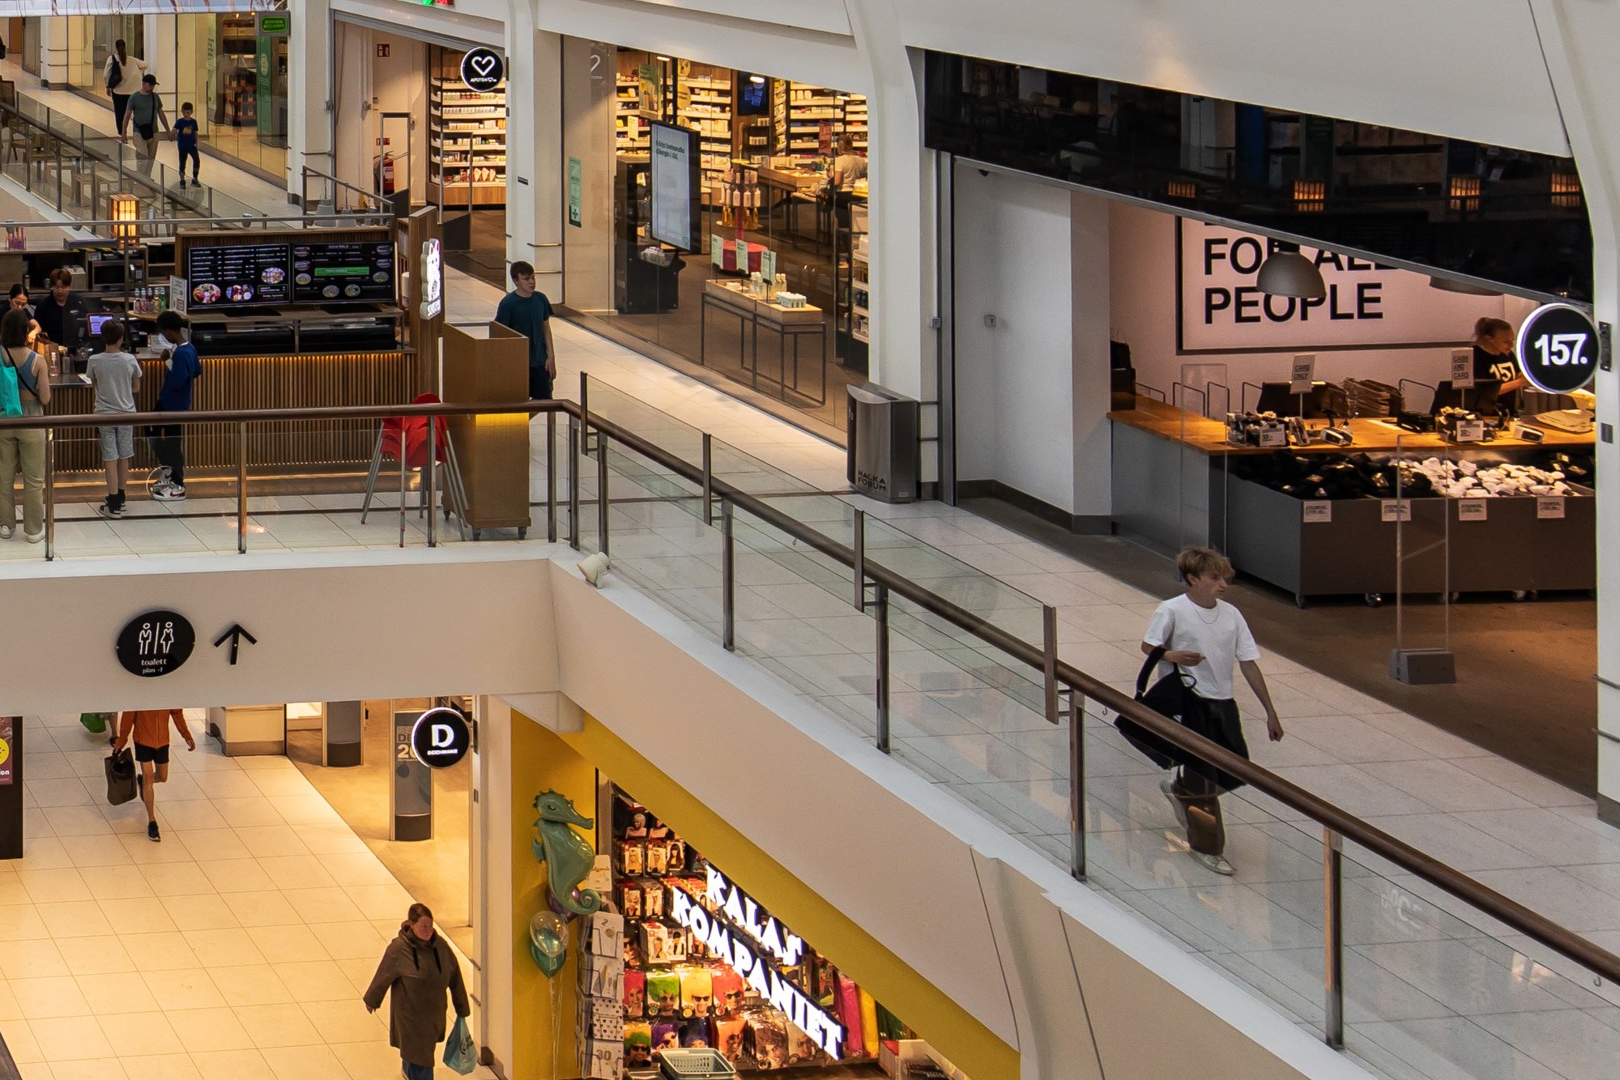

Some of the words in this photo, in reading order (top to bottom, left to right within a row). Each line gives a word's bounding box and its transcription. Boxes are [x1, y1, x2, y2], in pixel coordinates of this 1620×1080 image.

[1204, 281, 1384, 325] PEOPLE
[857, 469, 886, 485] NACKA
[857, 476, 887, 492] FORUM
[141, 658, 167, 666] toalett
[142, 667, 156, 675] plan
[431, 724, 455, 748] D
[705, 864, 808, 967] KALAS
[672, 885, 848, 1061] KOMPANIET
